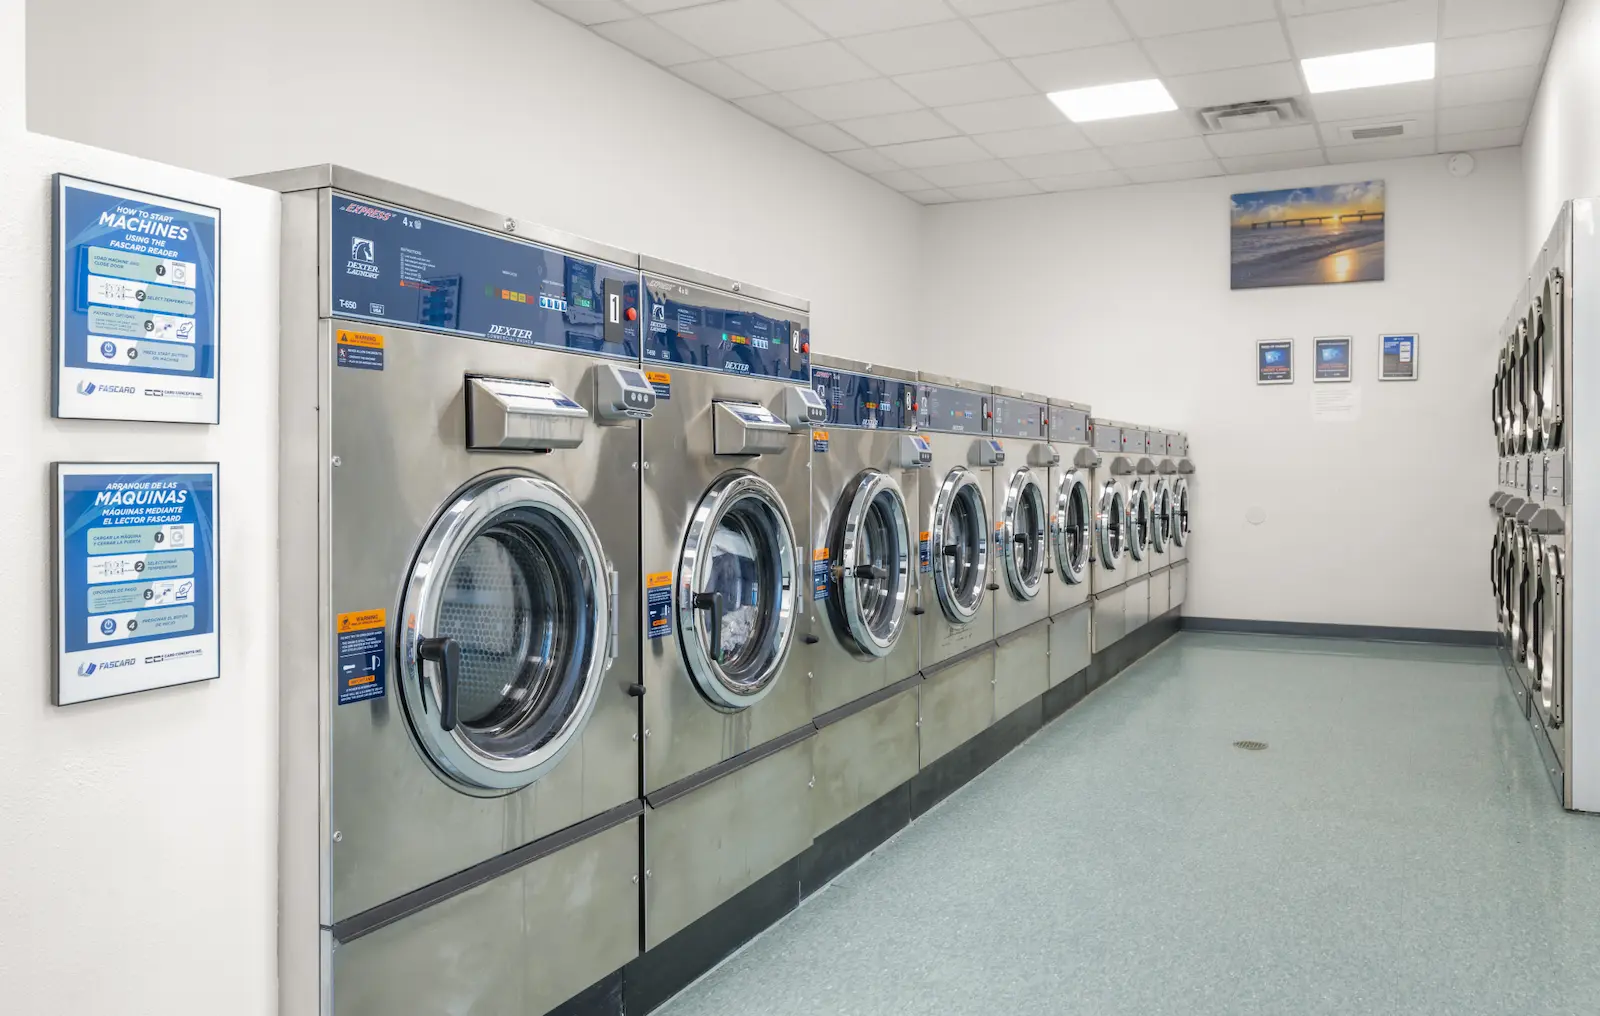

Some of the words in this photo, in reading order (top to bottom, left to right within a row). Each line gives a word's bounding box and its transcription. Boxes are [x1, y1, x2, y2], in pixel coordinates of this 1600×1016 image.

[116, 206, 137, 215] HOW
[150, 213, 173, 223] START
[345, 203, 392, 221] EXPRESS
[99, 212, 189, 240] MACHINES
[125, 234, 150, 244] USING
[151, 239, 166, 247] THE
[110, 240, 146, 252] FASCARD
[148, 247, 178, 258] READER
[347, 261, 379, 272] DEXTER
[346, 268, 379, 279] LAUNDRY
[339, 299, 357, 309] T-650
[612, 297, 617, 321] 1
[489, 324, 532, 339] DEXTER
[725, 361, 749, 371] DEXTER
[99, 385, 135, 394] FASCARD
[95, 488, 187, 506] MÁQUINAS
[102, 507, 144, 516] MÁQUINAS
[115, 516, 145, 524] LECTOR
[99, 658, 136, 670] FASCARD
